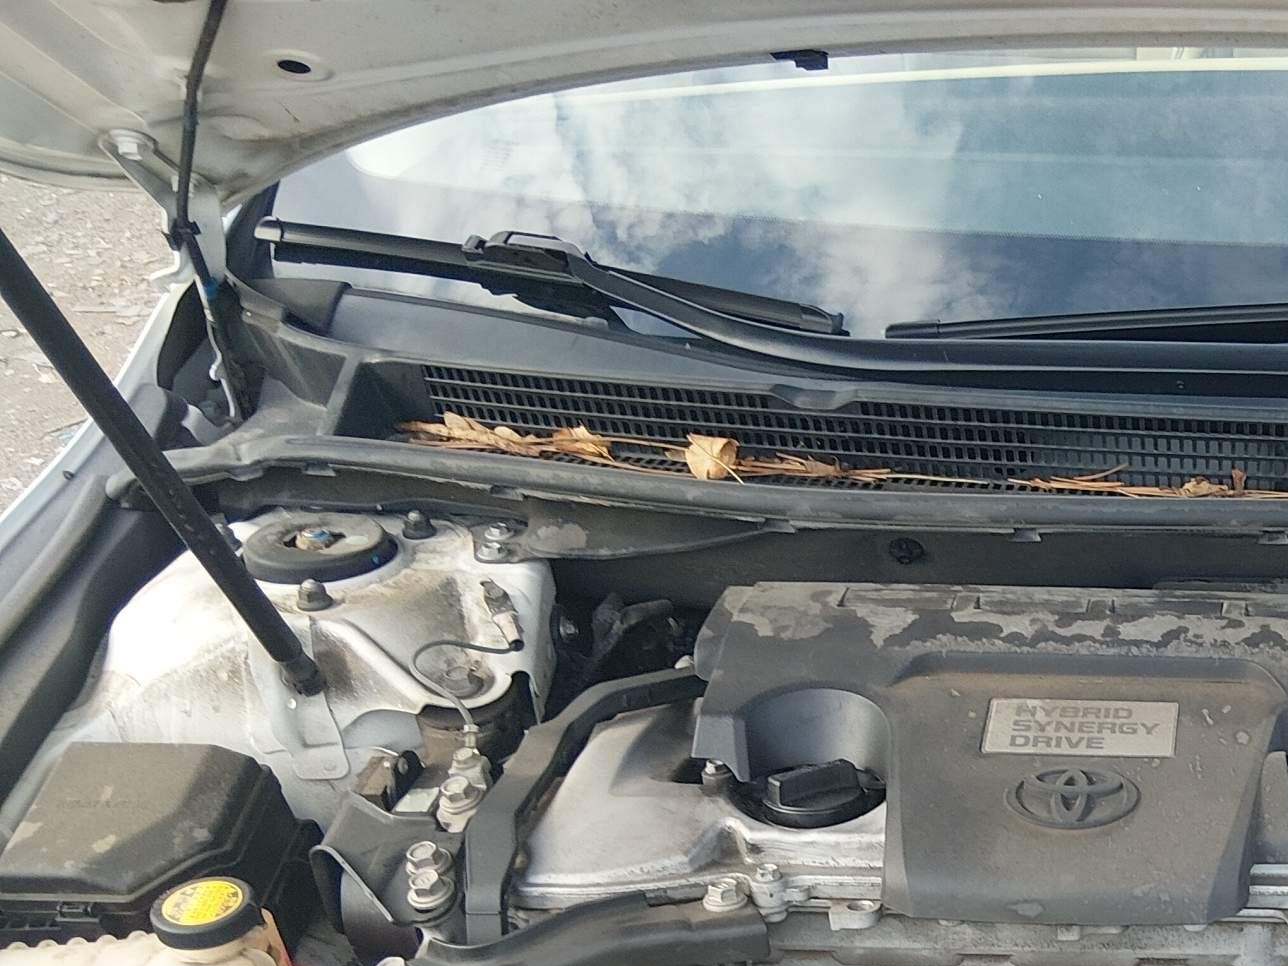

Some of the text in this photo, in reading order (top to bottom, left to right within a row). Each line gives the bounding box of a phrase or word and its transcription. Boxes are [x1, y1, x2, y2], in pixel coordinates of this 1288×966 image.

[1015, 704, 1133, 719] HYBRID
[1012, 719, 1160, 736] SYNERGY
[1009, 734, 1105, 750] DRIVE
